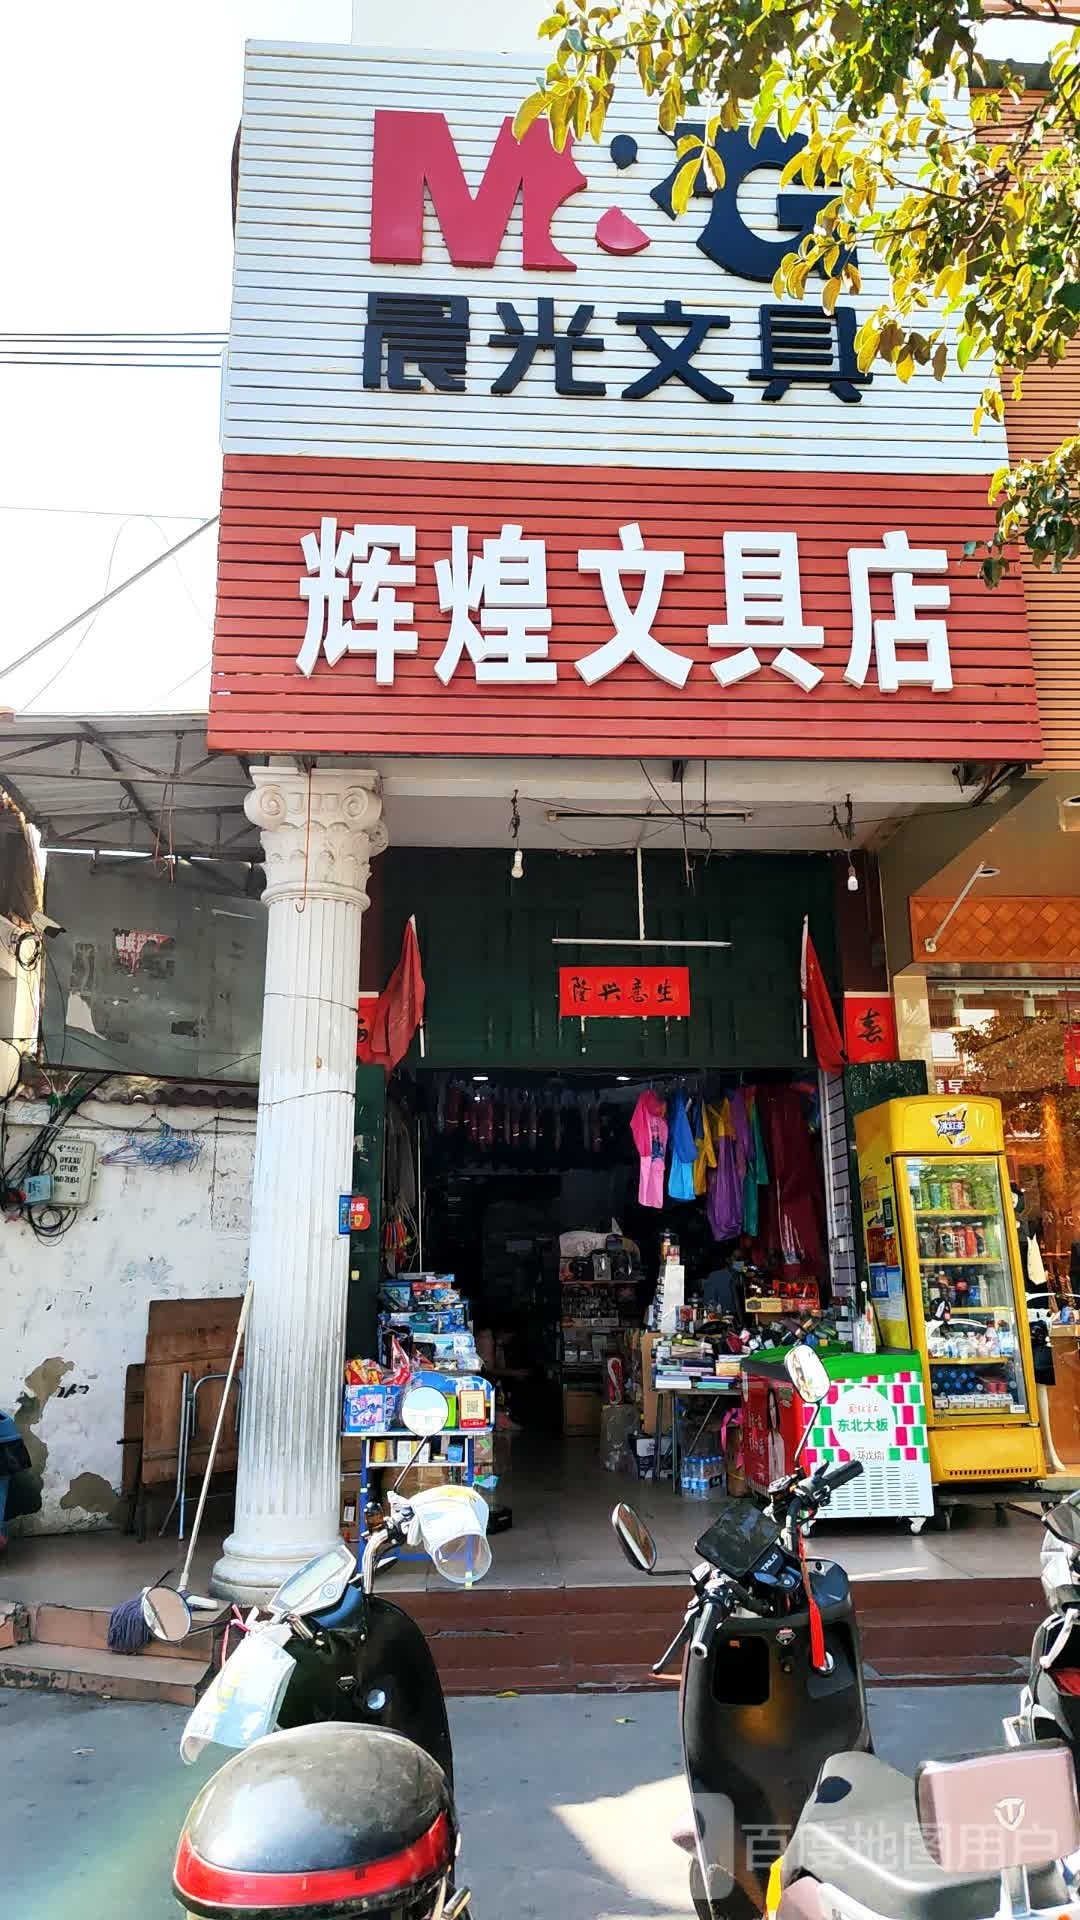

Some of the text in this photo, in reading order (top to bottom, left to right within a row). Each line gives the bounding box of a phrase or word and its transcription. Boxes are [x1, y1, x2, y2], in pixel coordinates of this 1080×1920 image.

[363, 292, 873, 403] 晨光文具
[296, 517, 951, 692] 辉煌文具店
[837, 1419, 888, 1432] 东北大板
